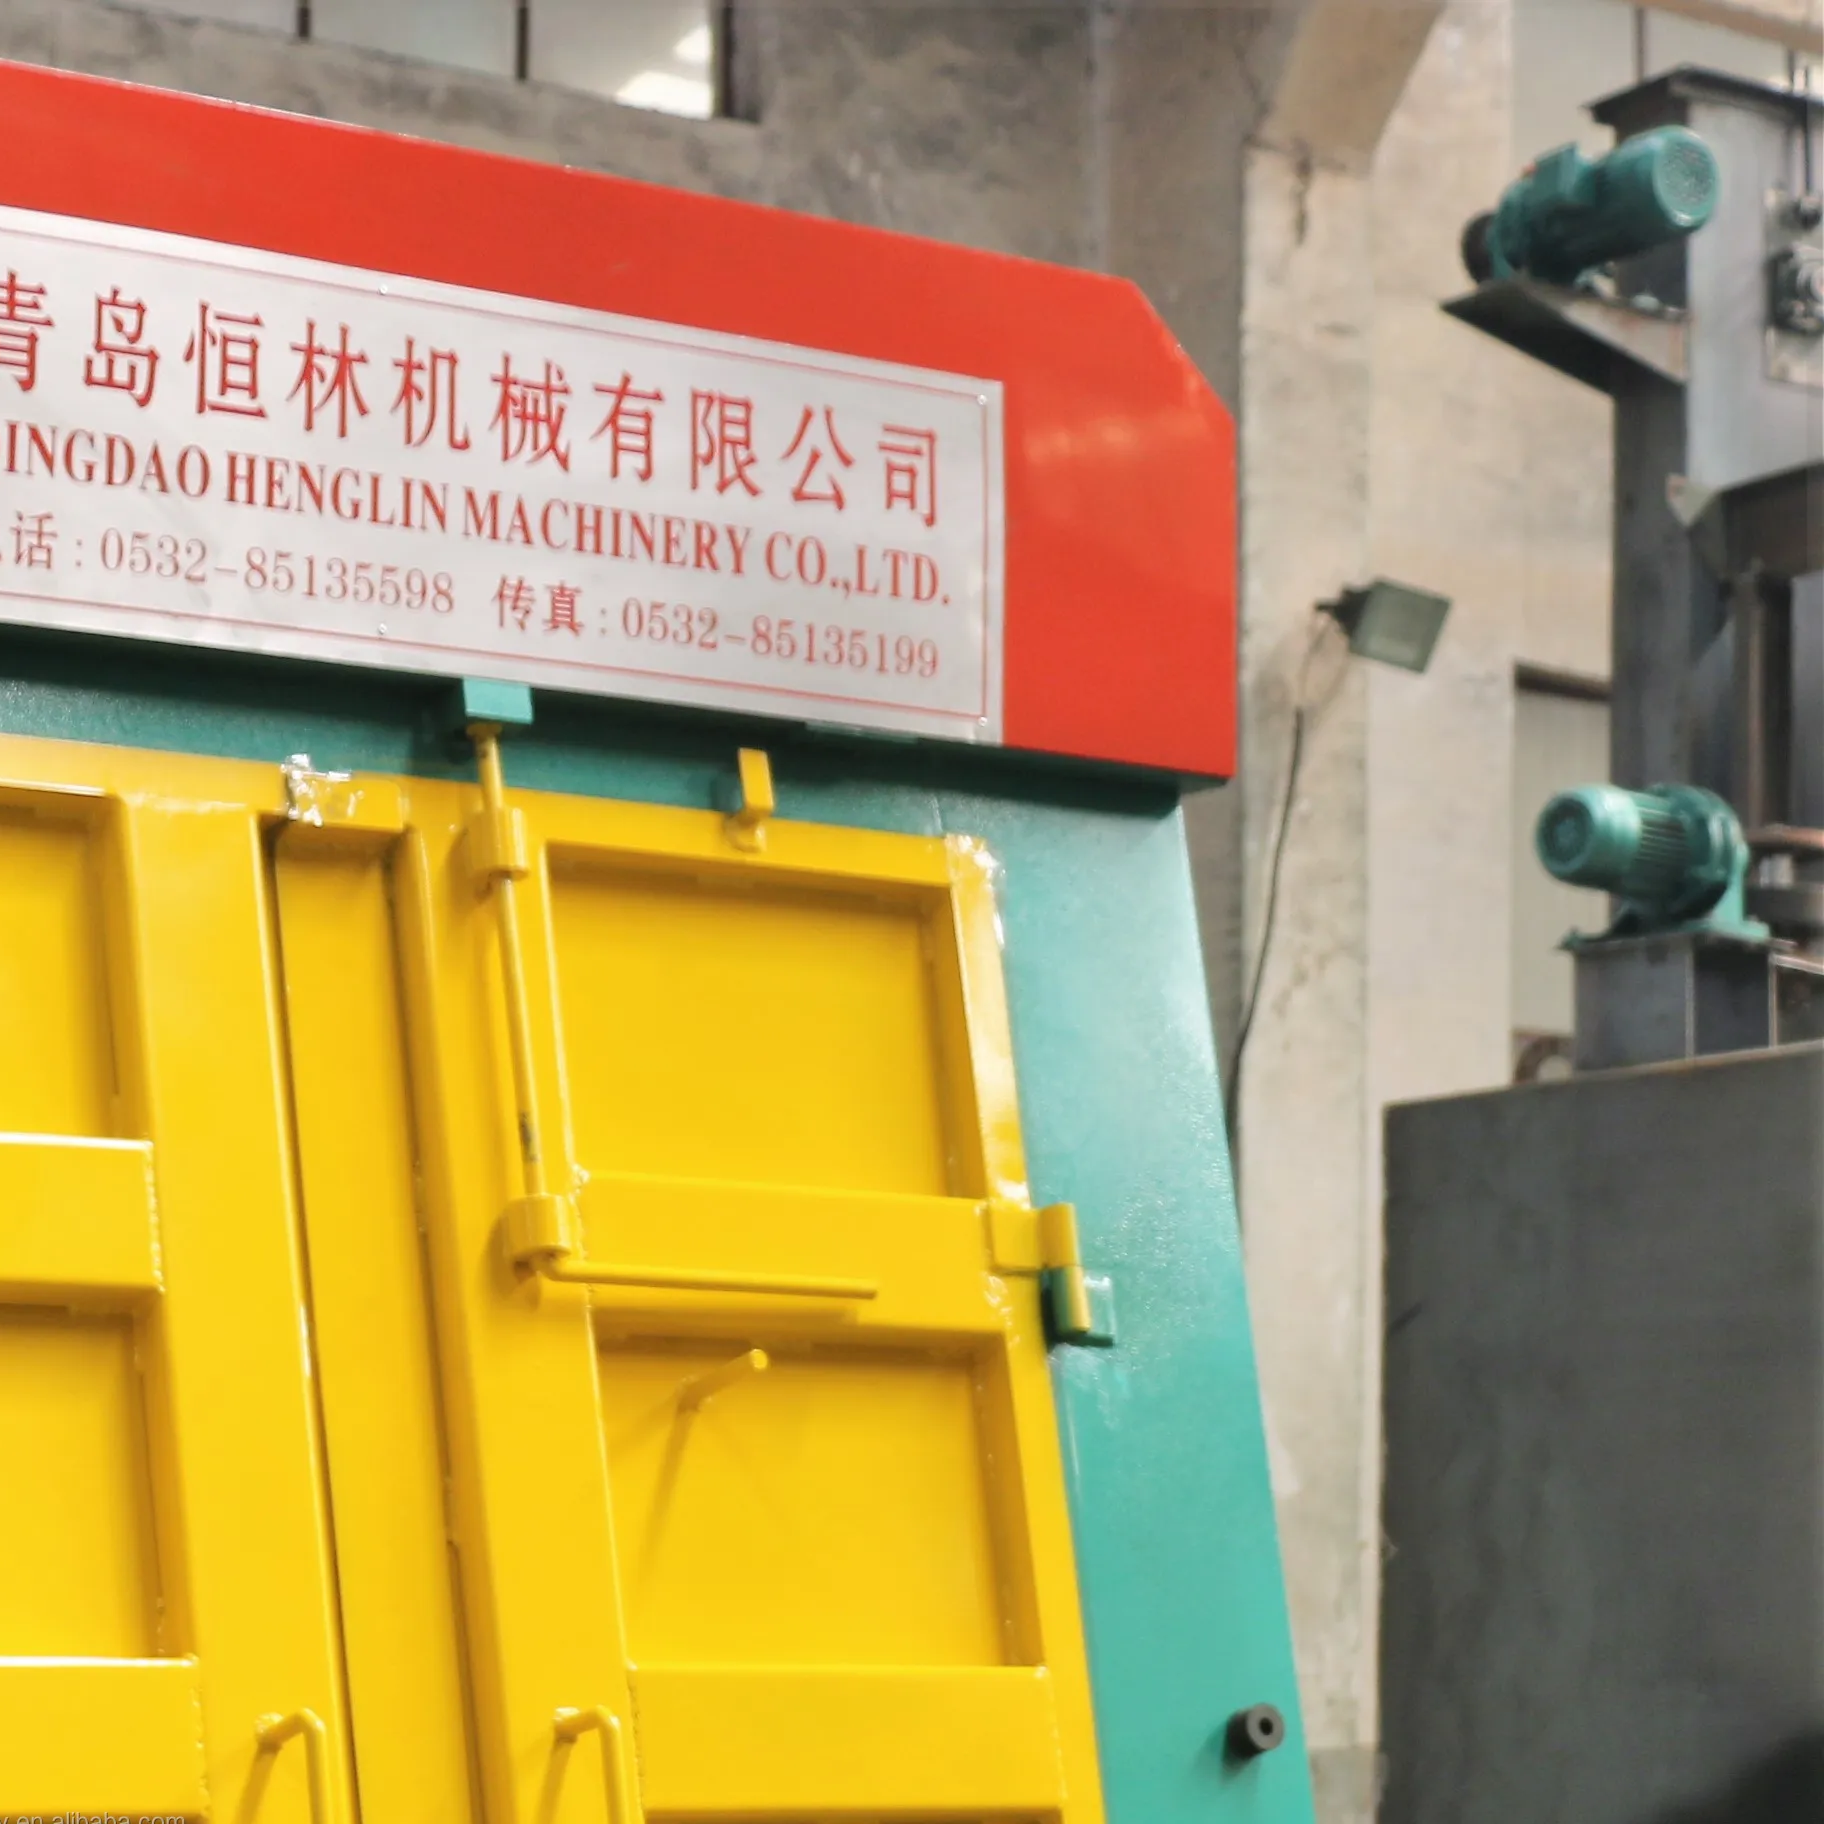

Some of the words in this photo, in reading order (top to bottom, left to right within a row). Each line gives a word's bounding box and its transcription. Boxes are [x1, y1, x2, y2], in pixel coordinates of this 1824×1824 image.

[225, 450, 450, 534] HENGLIN
[462, 485, 753, 577] MACHINERY
[764, 530, 952, 606] CO.,LTD.
